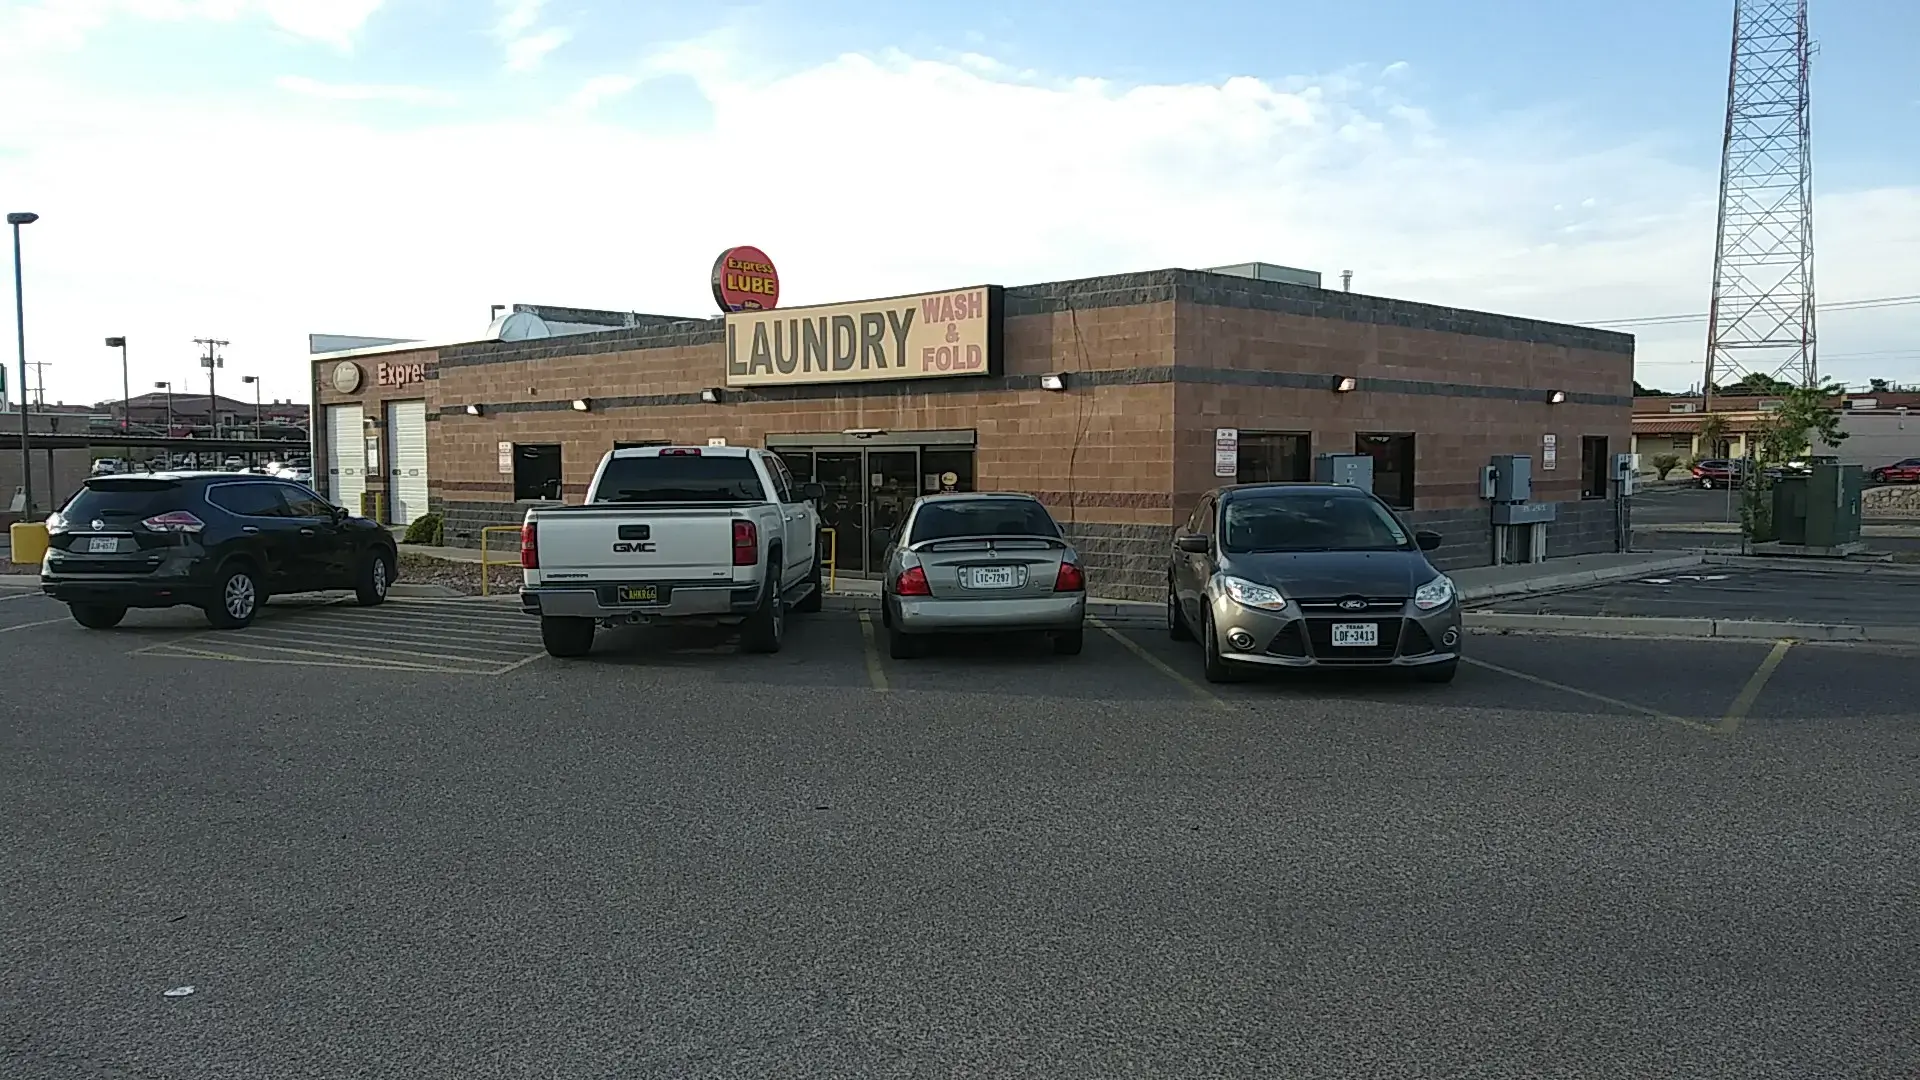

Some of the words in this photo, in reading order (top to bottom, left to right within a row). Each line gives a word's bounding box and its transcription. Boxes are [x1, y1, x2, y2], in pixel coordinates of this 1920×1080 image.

[728, 257, 773, 273] Express
[727, 273, 775, 295] LUBE
[921, 292, 983, 324] WASH
[728, 307, 917, 376] LAUNDRY
[945, 323, 960, 343] &
[922, 344, 982, 372] FOLD
[613, 542, 656, 553] GMC
